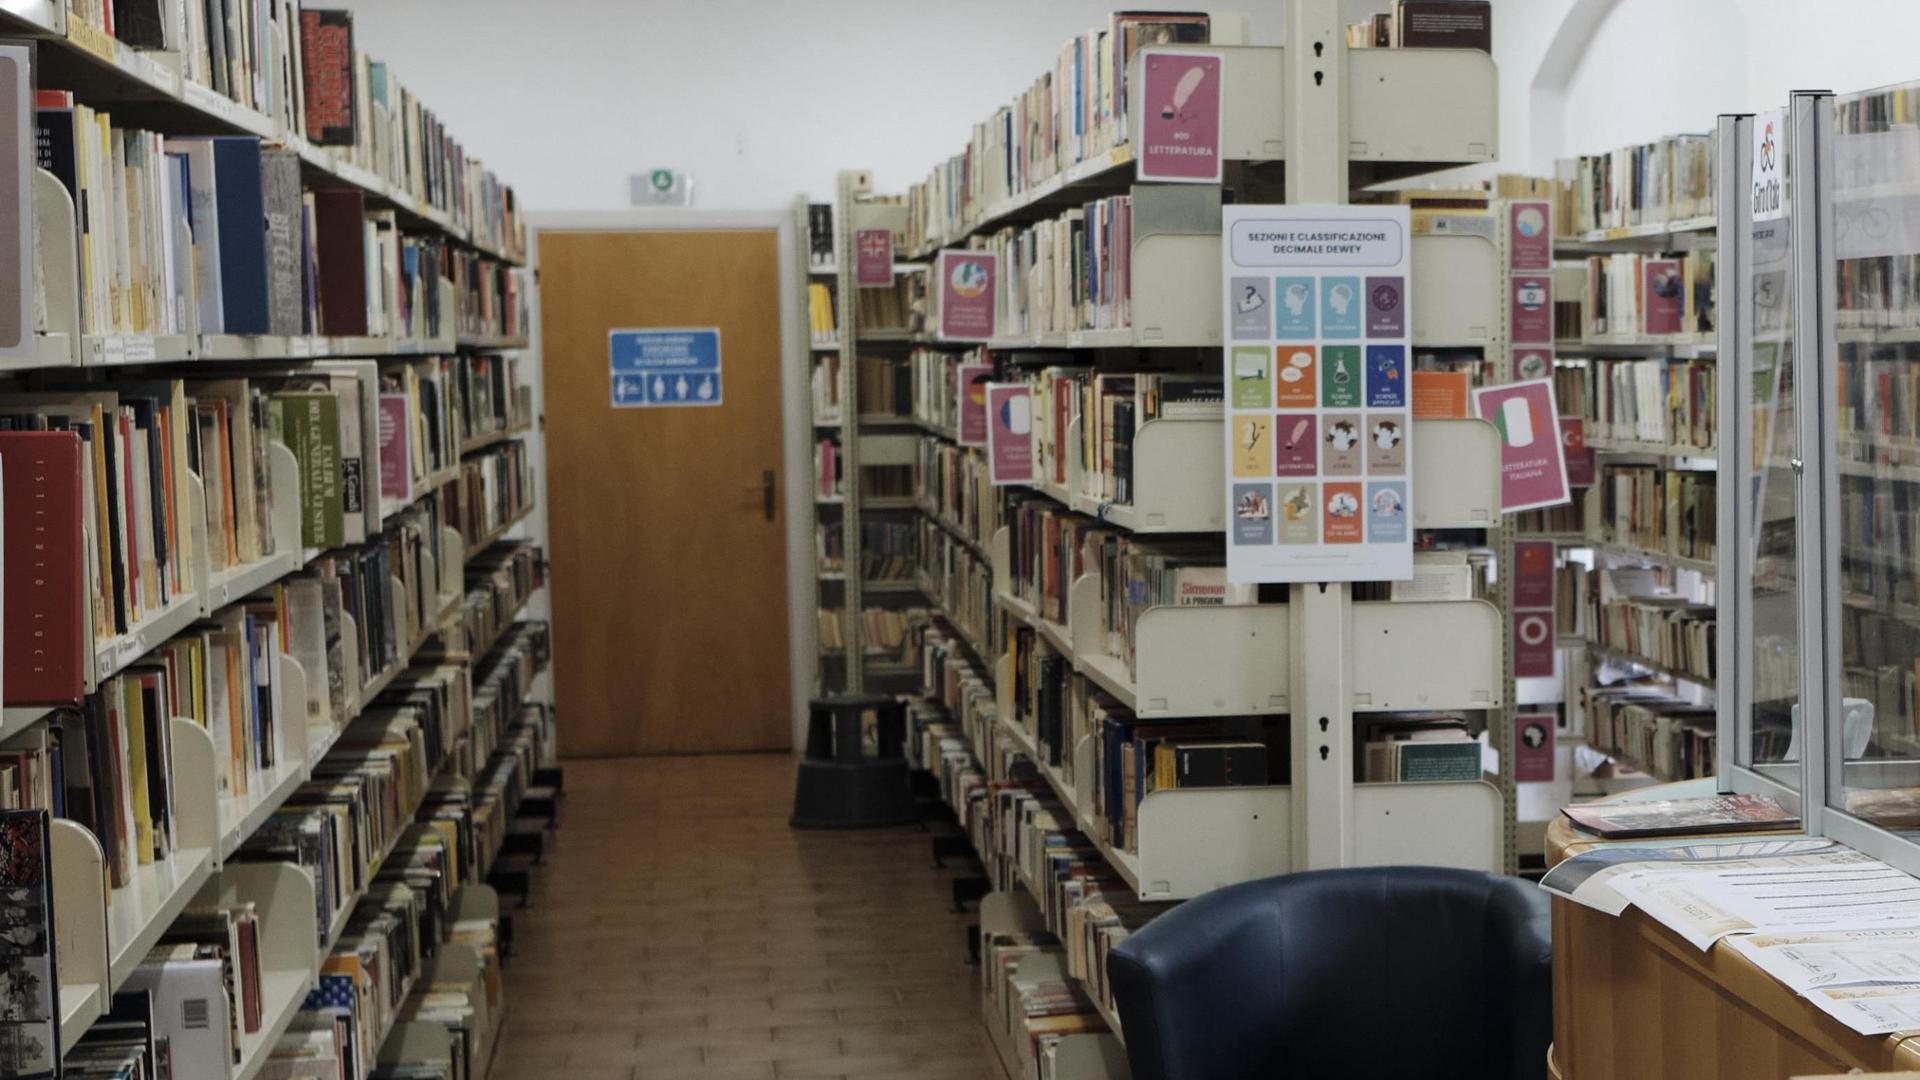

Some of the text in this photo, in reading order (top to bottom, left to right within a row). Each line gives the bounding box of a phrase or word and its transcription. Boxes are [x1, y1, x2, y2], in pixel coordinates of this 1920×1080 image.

[1149, 145, 1213, 156] LETTERATURA
[270, 212, 289, 243] BIT
[1248, 232, 1387, 242] SEZIONI E CLASSIFICAZIONE
[1273, 245, 1361, 254] DECIMALE DEWEY
[309, 399, 325, 544] DEL GENERALE CUSTER
[34, 459, 45, 673] ISTITUTO LUCE
[1182, 582, 1226, 595] Simenon
